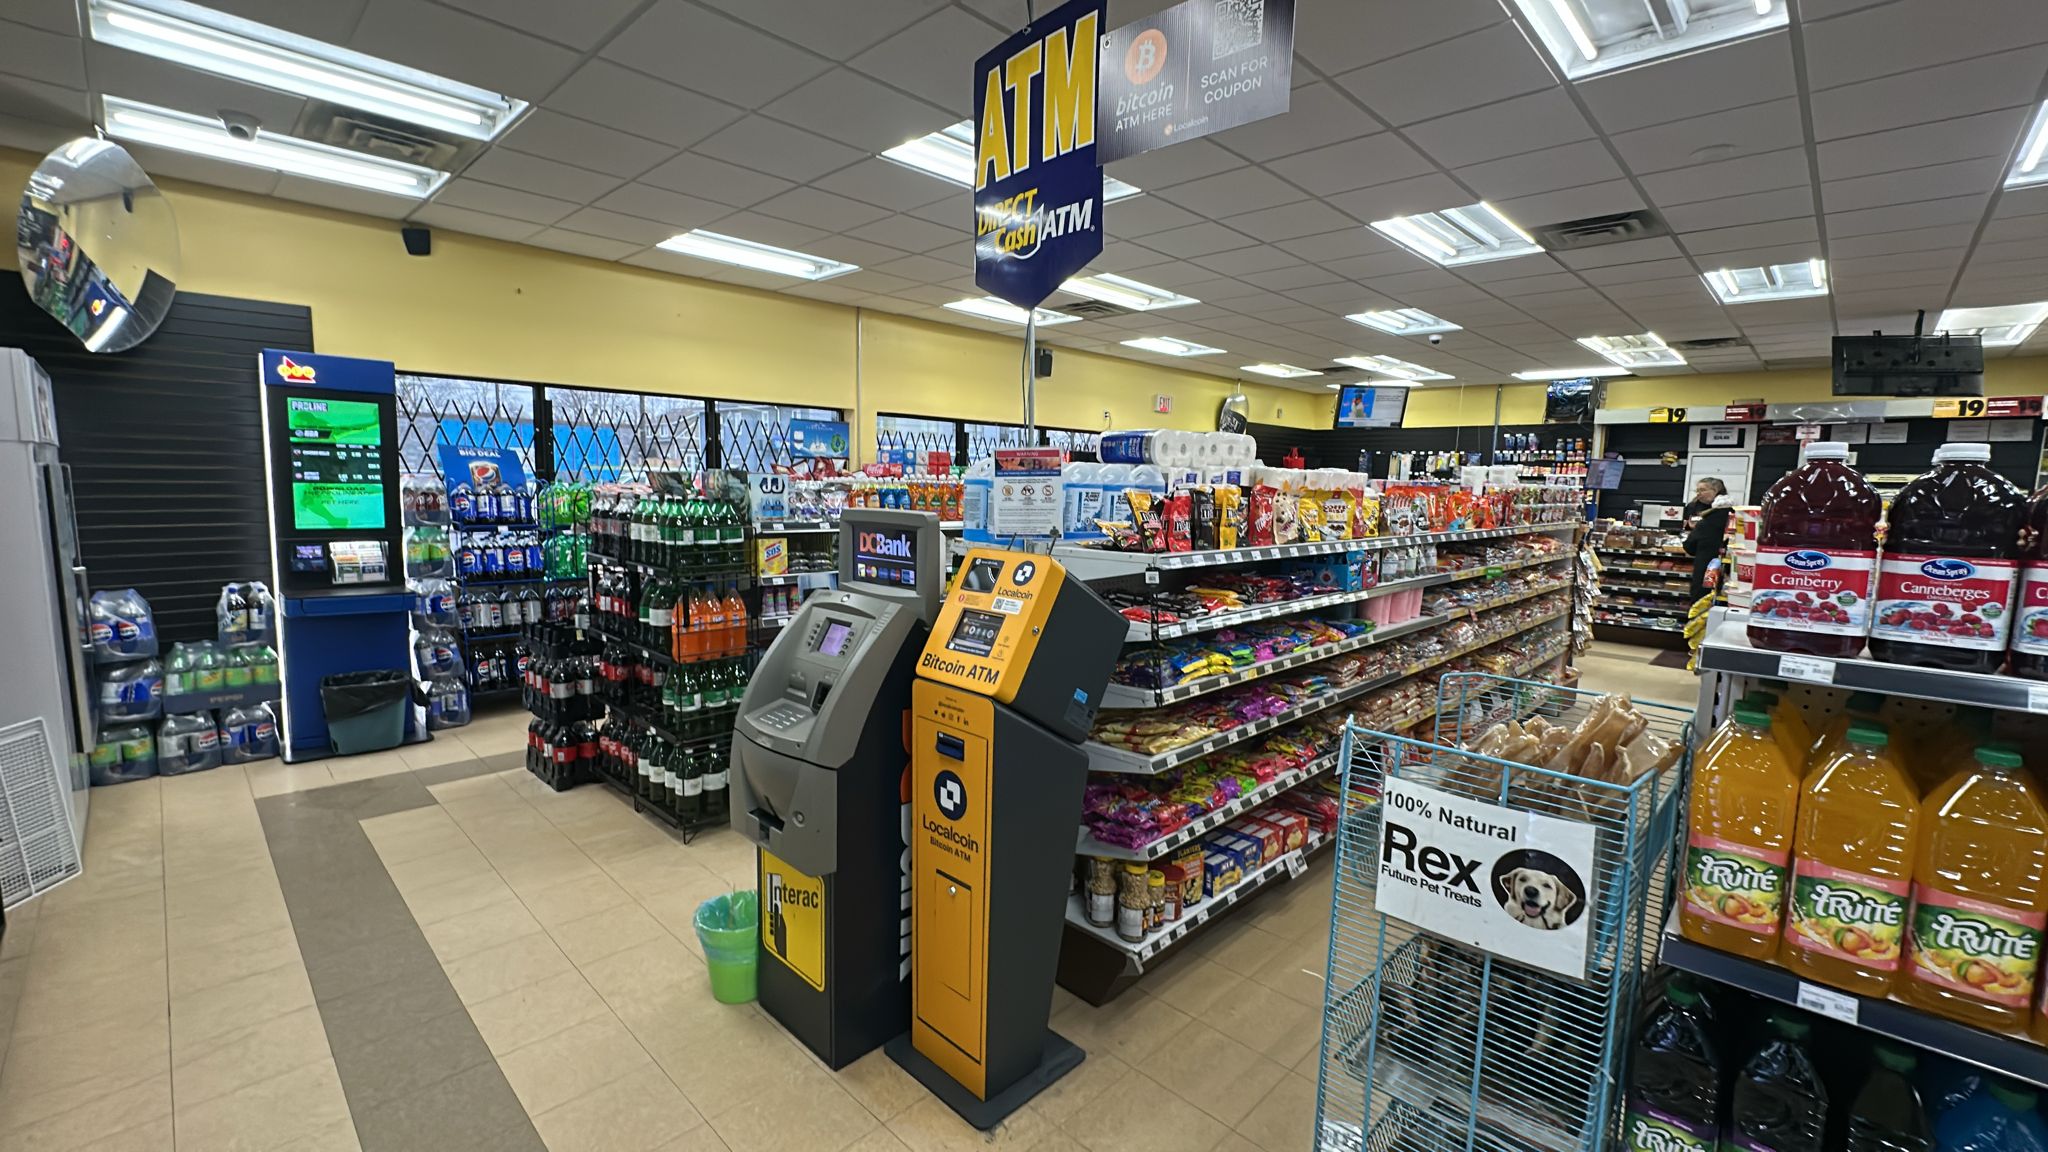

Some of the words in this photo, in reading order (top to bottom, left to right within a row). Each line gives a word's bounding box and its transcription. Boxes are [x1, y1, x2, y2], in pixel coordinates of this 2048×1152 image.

[1200, 66, 1238, 88] SCAN
[1240, 55, 1268, 79] FOR
[976, 9, 1098, 192] ATM
[1115, 81, 1175, 118] bitcoin
[1203, 75, 1263, 105] COUPON
[1115, 112, 1140, 132] ATM
[1142, 103, 1174, 123] HERE
[977, 188, 1038, 237] DIRECT
[291, 400, 329, 412] PROLINE
[1667, 407, 1686, 423] 19
[1958, 399, 1985, 417] 19
[458, 448, 477, 457] BIG
[478, 450, 502, 458] DEAL
[860, 532, 912, 558] DCBank
[1786, 555, 1806, 566] Ocean
[1806, 559, 1825, 568] Spray
[1923, 565, 1947, 577] Ocean
[1946, 567, 1968, 578] Spray
[997, 586, 1033, 601] Localcoin
[1770, 573, 1843, 592] Cranberry
[1900, 581, 1990, 600] Canneberges
[921, 652, 966, 678] Bitcoin
[966, 663, 1000, 686] ATM
[1385, 789, 1433, 820] 100%
[1438, 806, 1516, 843] Natural
[922, 813, 979, 854] Localcoin
[929, 835, 954, 854] Bitcoin
[953, 848, 972, 863] ATM
[1382, 820, 1483, 895] Rex
[767, 874, 820, 914] Interac
[1381, 863, 1418, 887] Future
[1419, 878, 1440, 894] Pet
[1442, 886, 1483, 908] Treats
